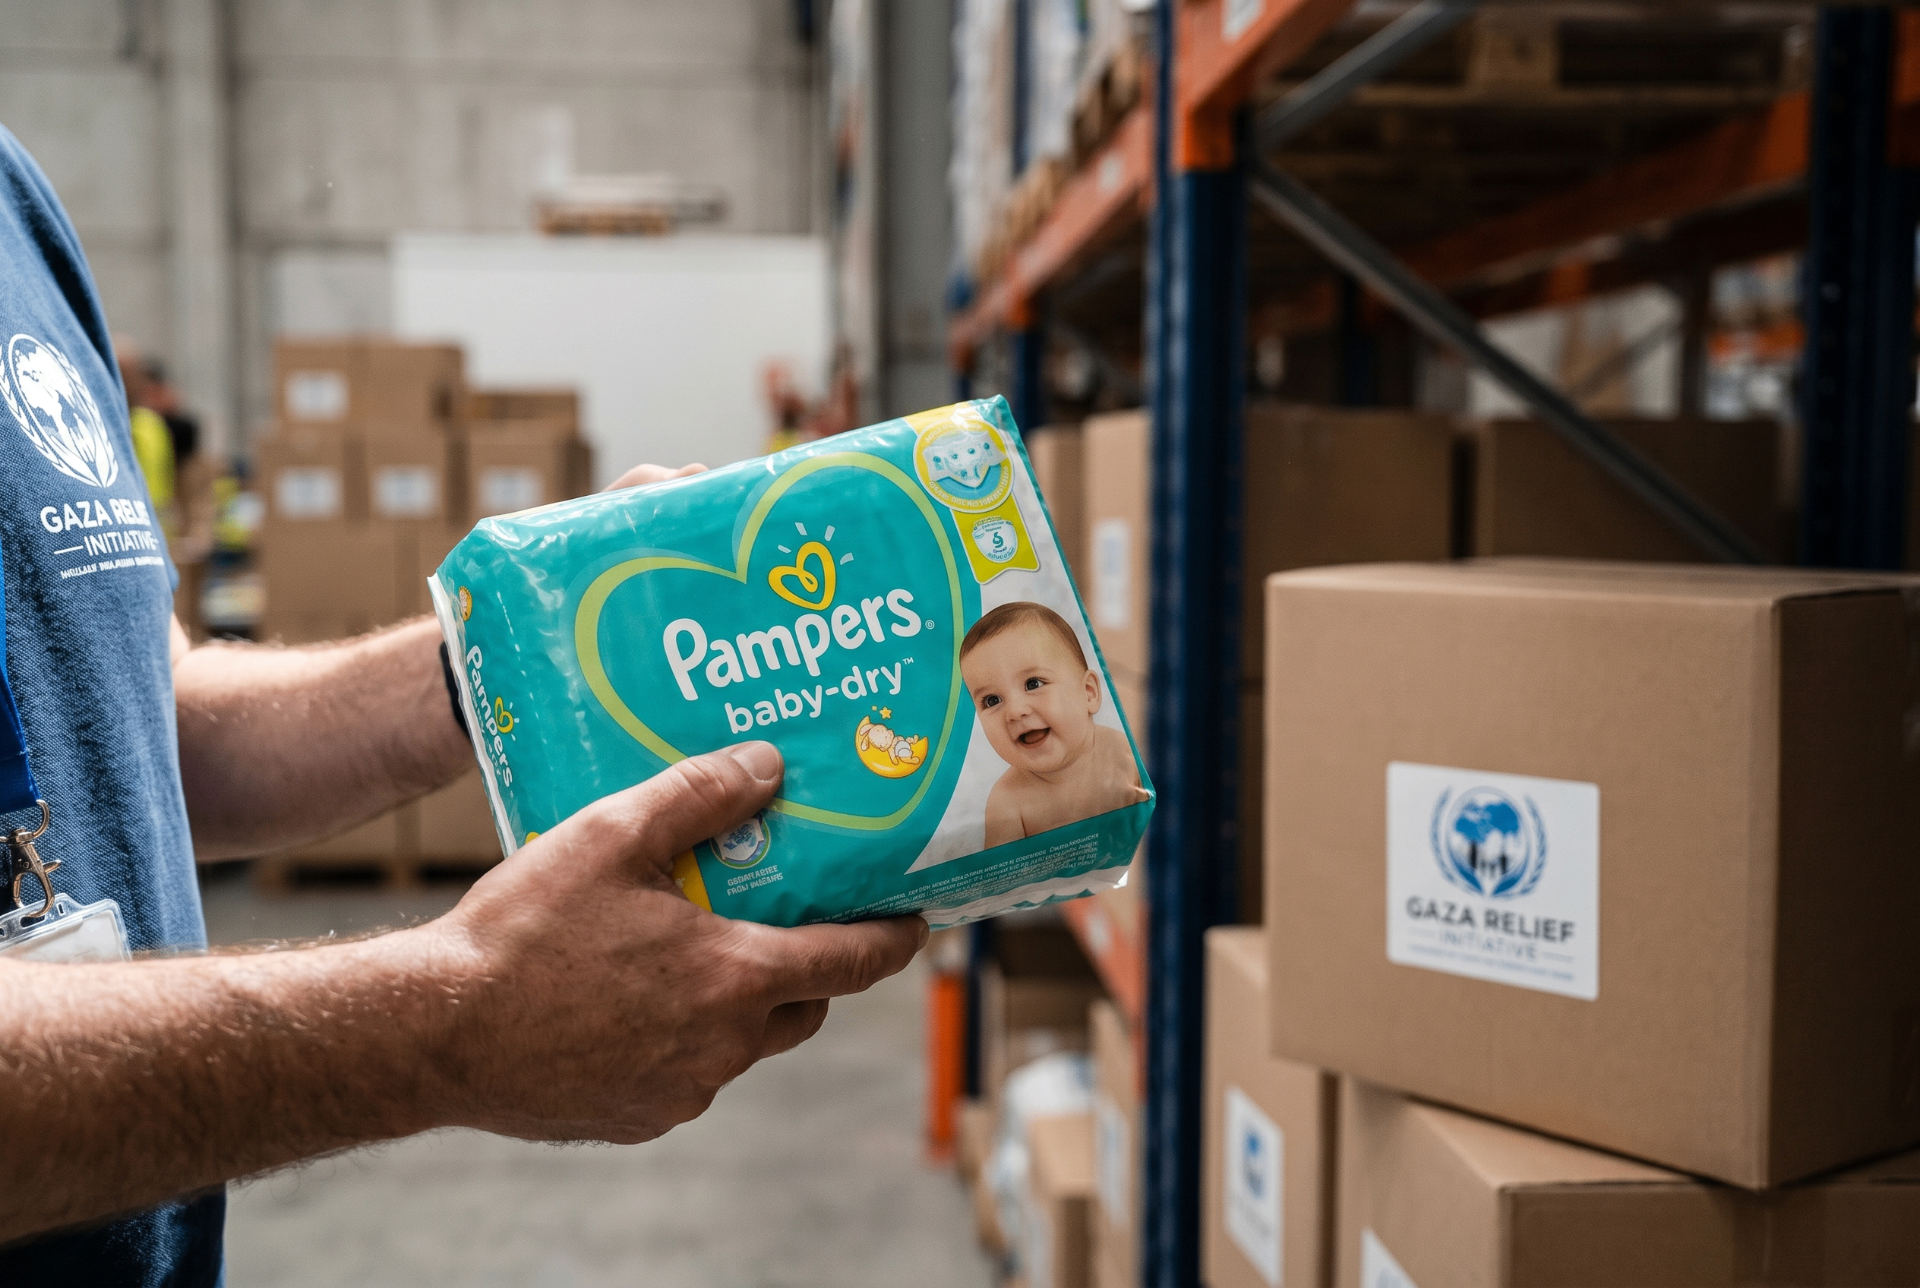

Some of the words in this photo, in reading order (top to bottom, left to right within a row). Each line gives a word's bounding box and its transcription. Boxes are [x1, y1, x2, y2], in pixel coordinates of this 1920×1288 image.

[40, 499, 113, 533] GAZA
[662, 588, 922, 701] Pampers
[467, 645, 513, 788] Pampers
[1406, 896, 1476, 927] GAZA
[1484, 908, 1575, 943] RELIEF
